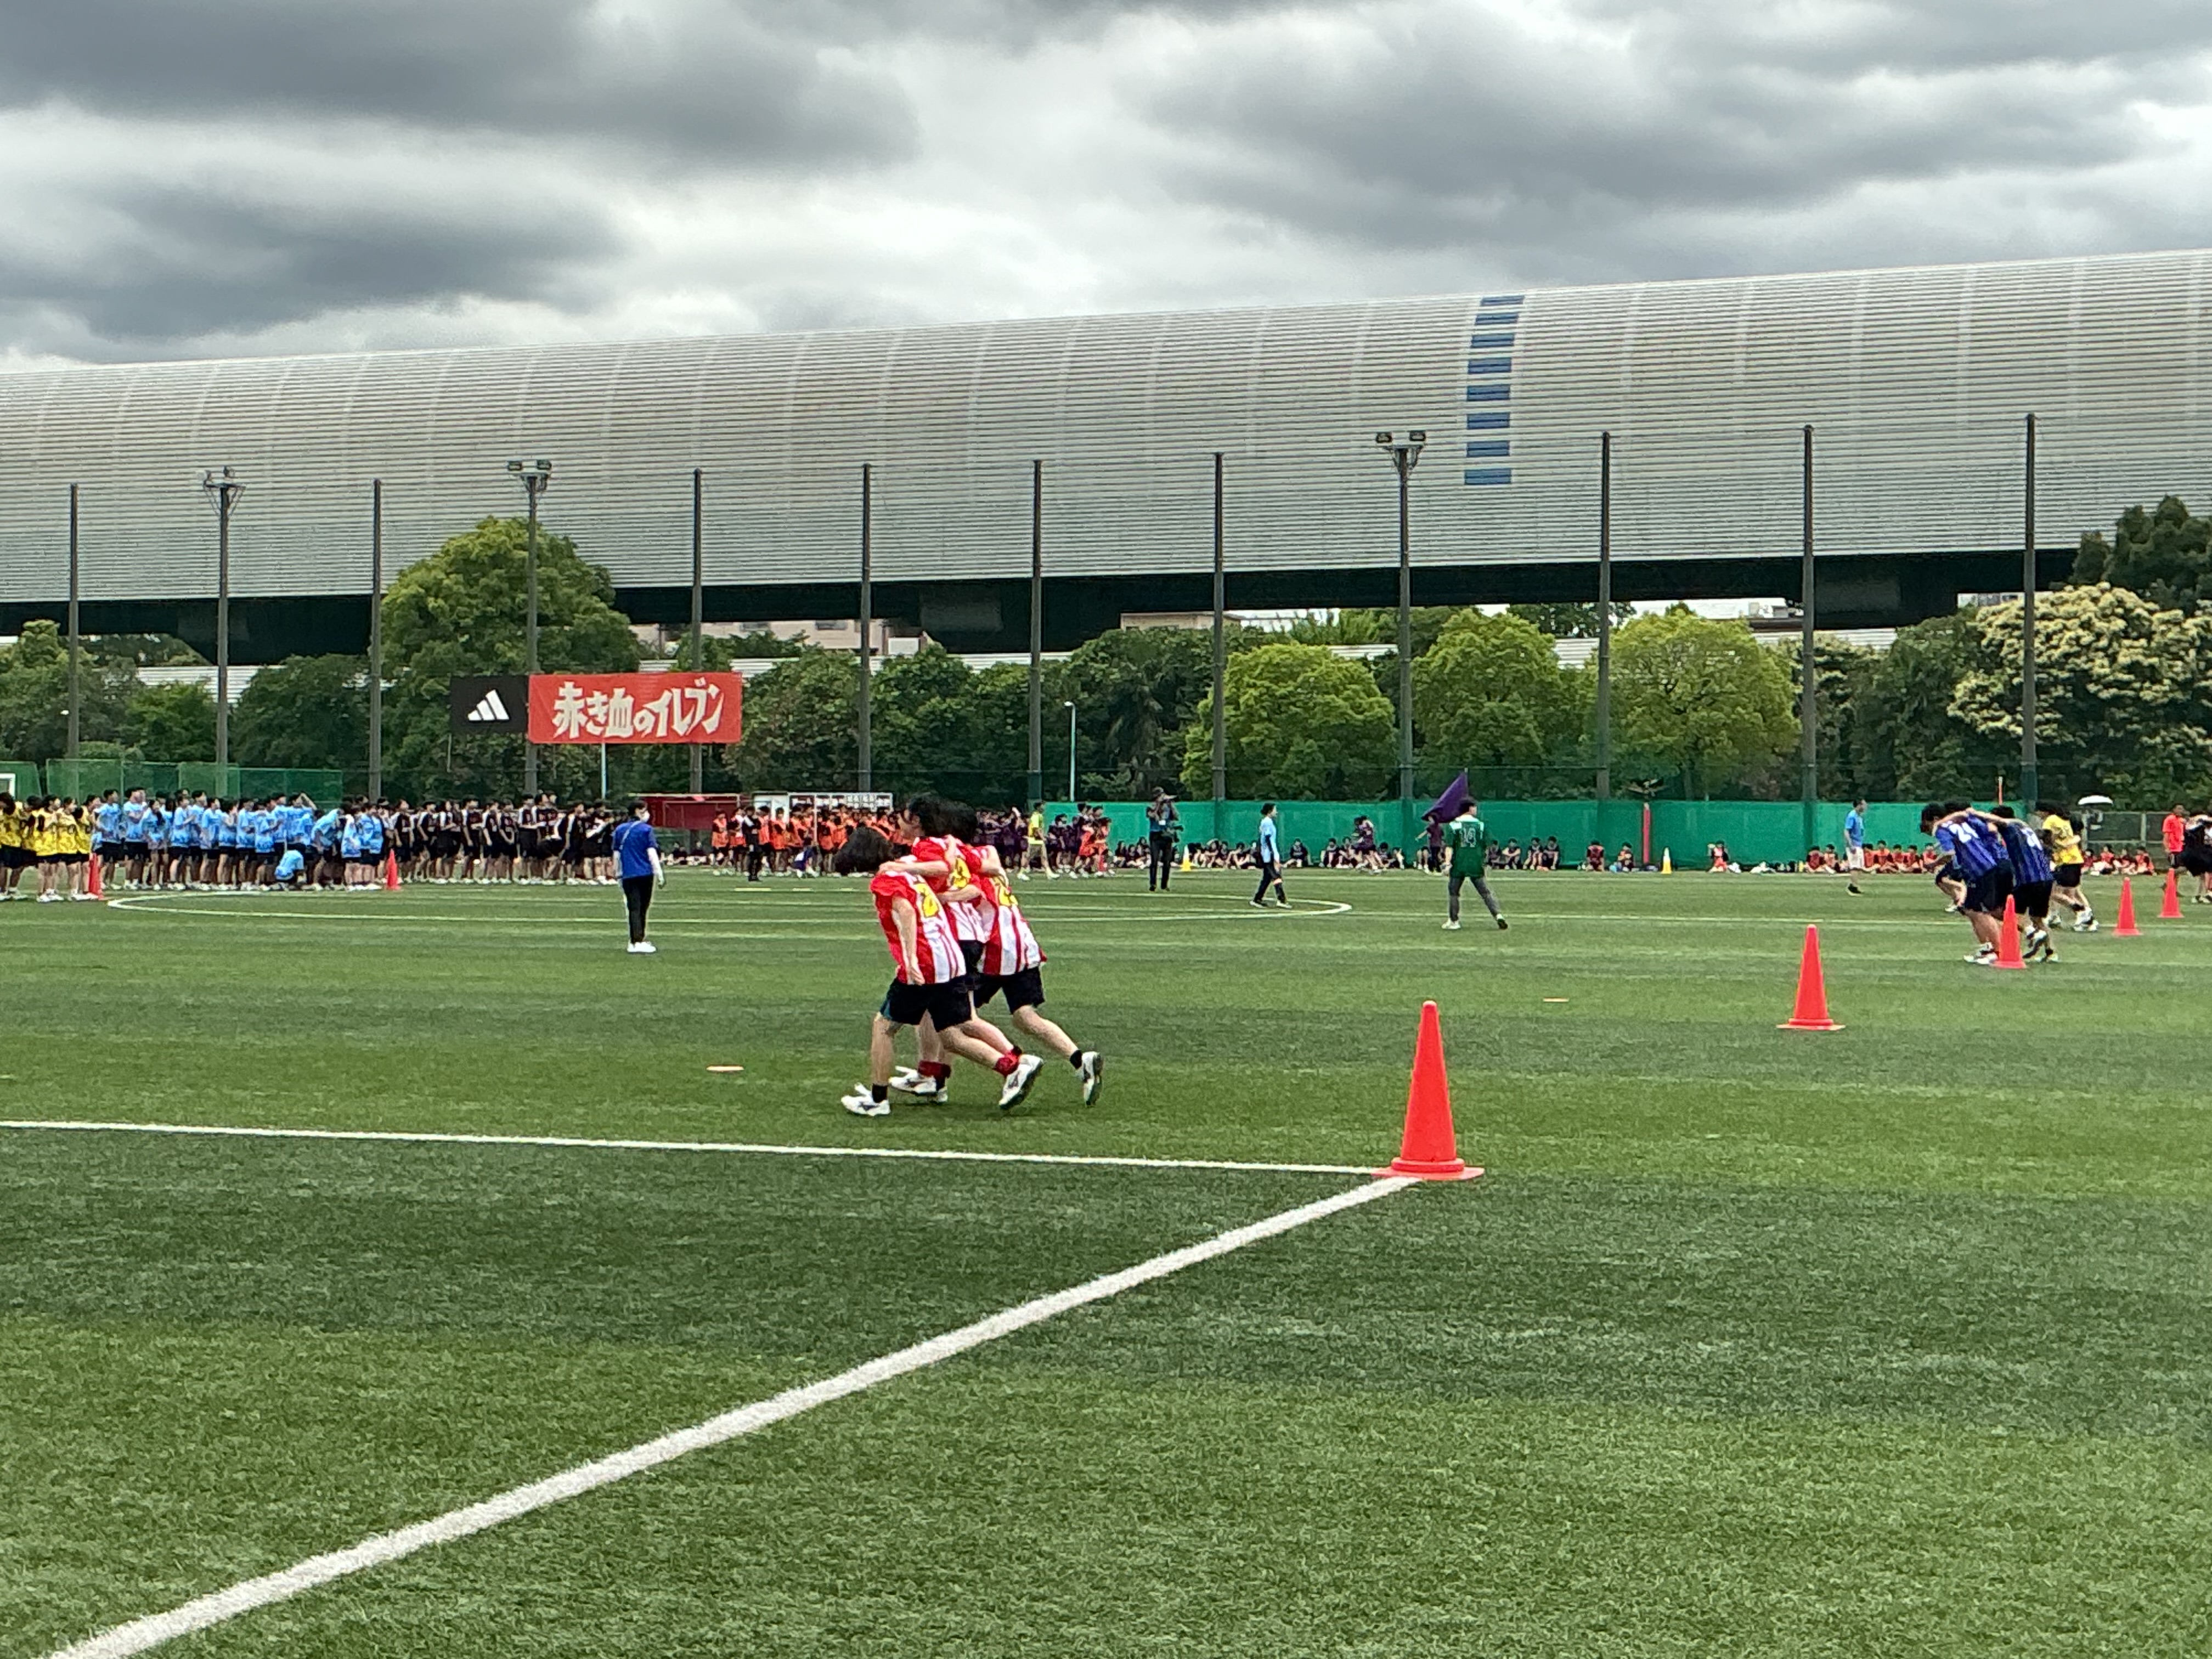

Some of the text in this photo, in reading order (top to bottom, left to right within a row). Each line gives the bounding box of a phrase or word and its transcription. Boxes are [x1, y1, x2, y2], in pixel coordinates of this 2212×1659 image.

[552, 677, 724, 739] 赤き血のイレブン
